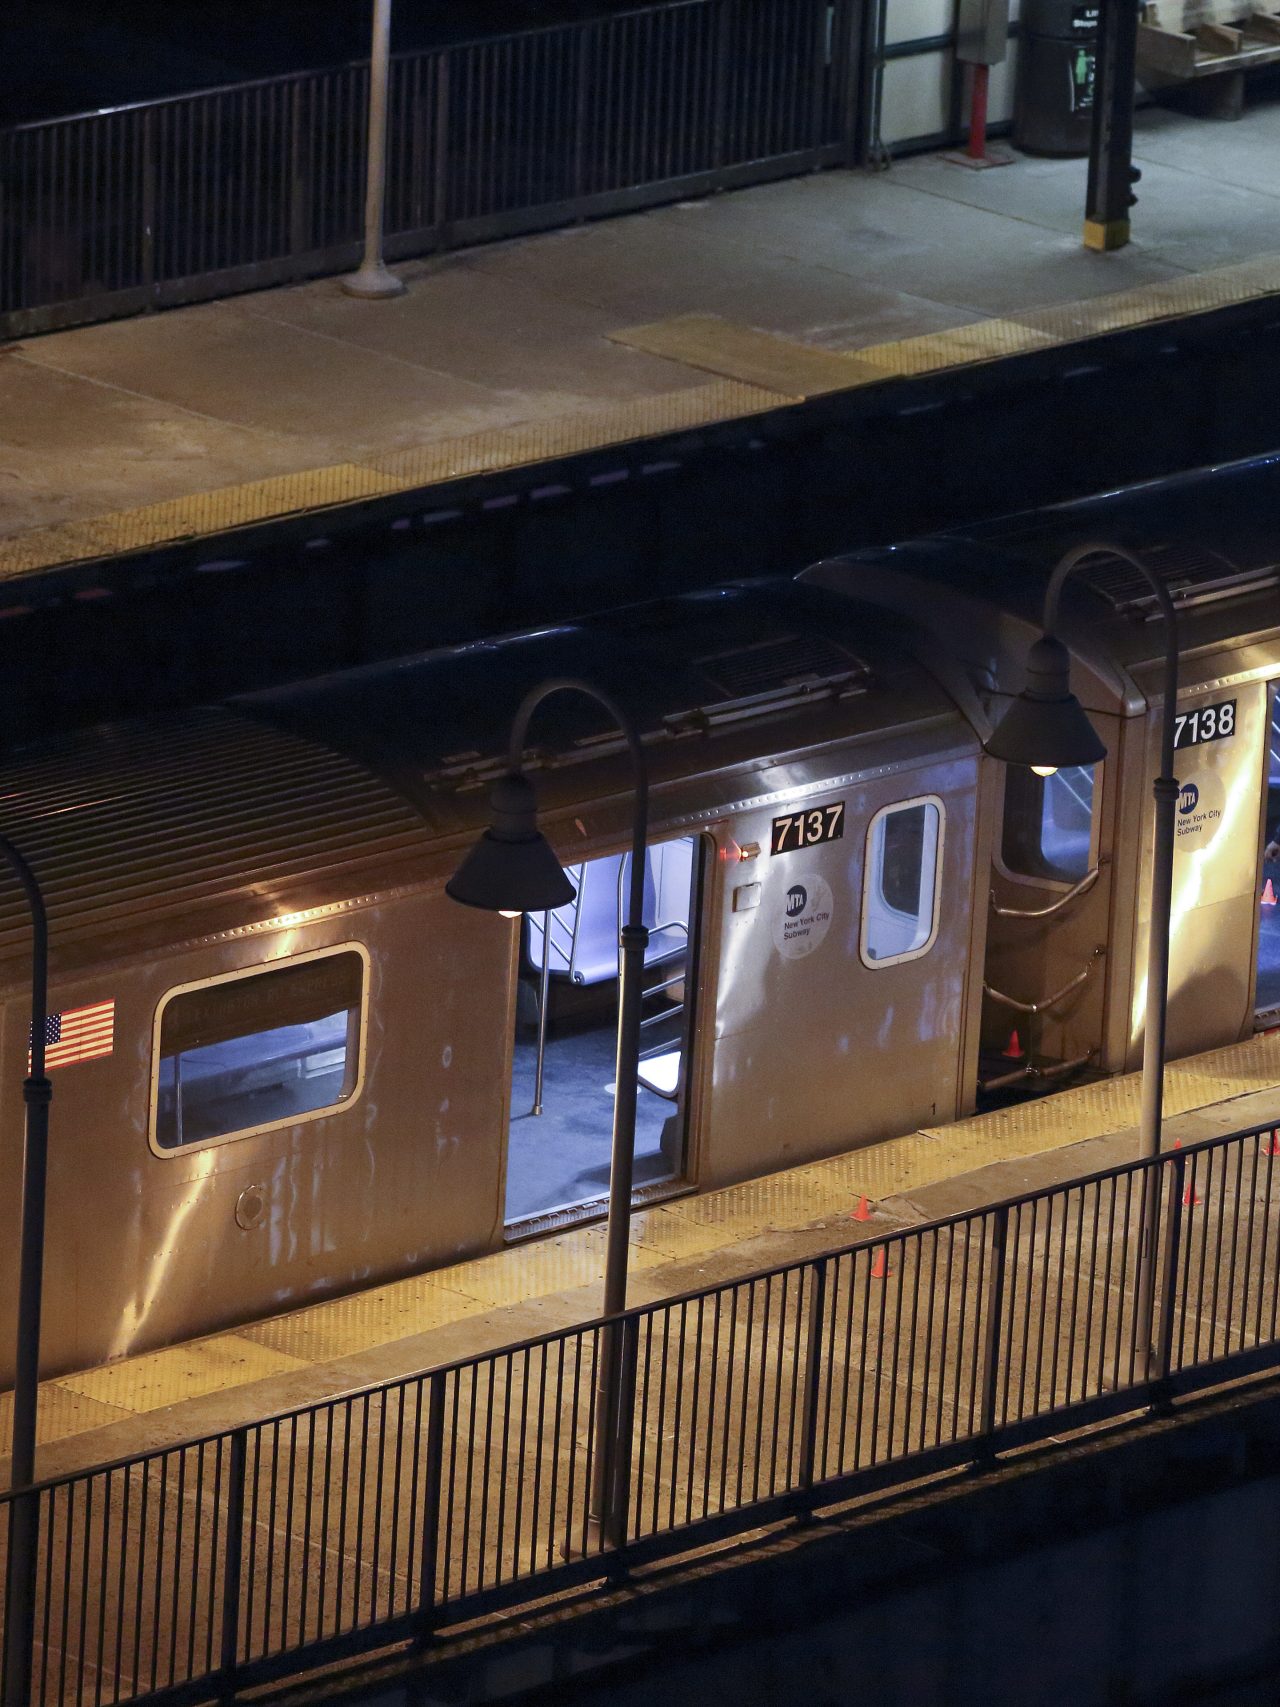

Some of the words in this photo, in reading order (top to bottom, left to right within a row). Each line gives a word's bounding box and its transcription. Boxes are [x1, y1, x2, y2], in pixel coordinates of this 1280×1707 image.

[1173, 703, 1234, 748] 7138
[1179, 792, 1195, 809] MTA
[1177, 818, 1191, 827] New
[1193, 813, 1207, 823] York
[1208, 809, 1221, 819] City
[775, 804, 844, 851] 7137
[1177, 825, 1202, 836] Subway
[786, 894, 804, 912] MTA
[784, 921, 798, 930] New
[799, 916, 815, 927] York
[816, 912, 830, 922] City
[783, 928, 809, 940] Subway
